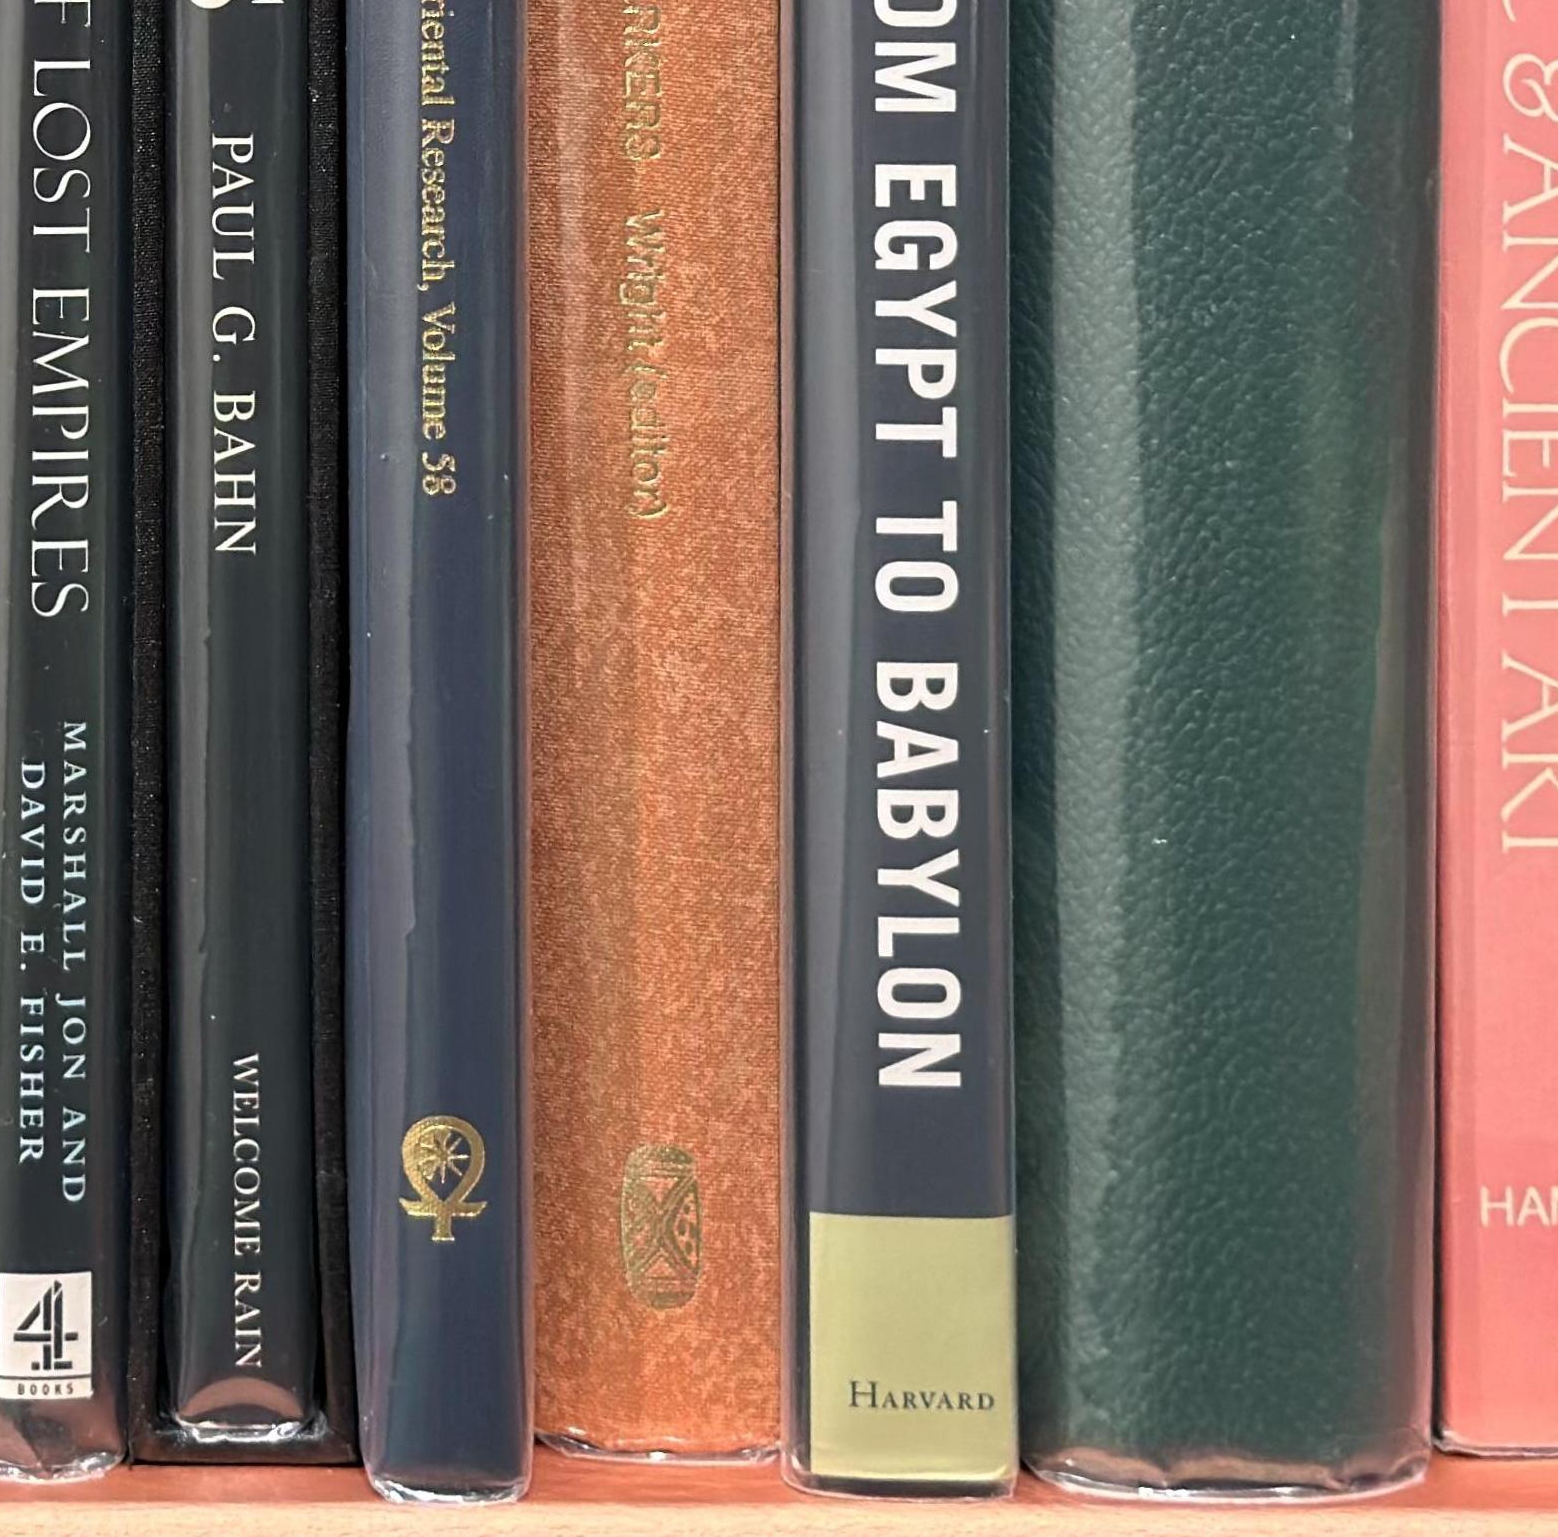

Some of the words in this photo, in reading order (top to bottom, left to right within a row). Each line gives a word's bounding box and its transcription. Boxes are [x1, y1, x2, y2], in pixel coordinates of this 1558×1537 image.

[32, 58, 93, 253] LOST
[209, 131, 256, 280] PAUL
[416, 117, 457, 292] Research,
[211, 307, 256, 364] G.
[420, 301, 456, 440] Volume
[872, 162, 958, 458] EGYPT
[29, 287, 92, 618] EMPIRES
[212, 390, 258, 556] BAHN
[419, 450, 457, 496] 58
[873, 499, 961, 613] TO
[19, 762, 46, 907] DAVID
[60, 720, 87, 972] MARSHALL
[874, 661, 962, 1088] BABYLON
[19, 931, 46, 971] E.
[19, 996, 46, 1164] FISHER
[57, 995, 87, 1081] JON
[60, 1106, 86, 1204] AND
[231, 1053, 260, 1257] WELCOME
[13, 1279, 79, 1370] 4
[233, 1272, 262, 1369] RAIN
